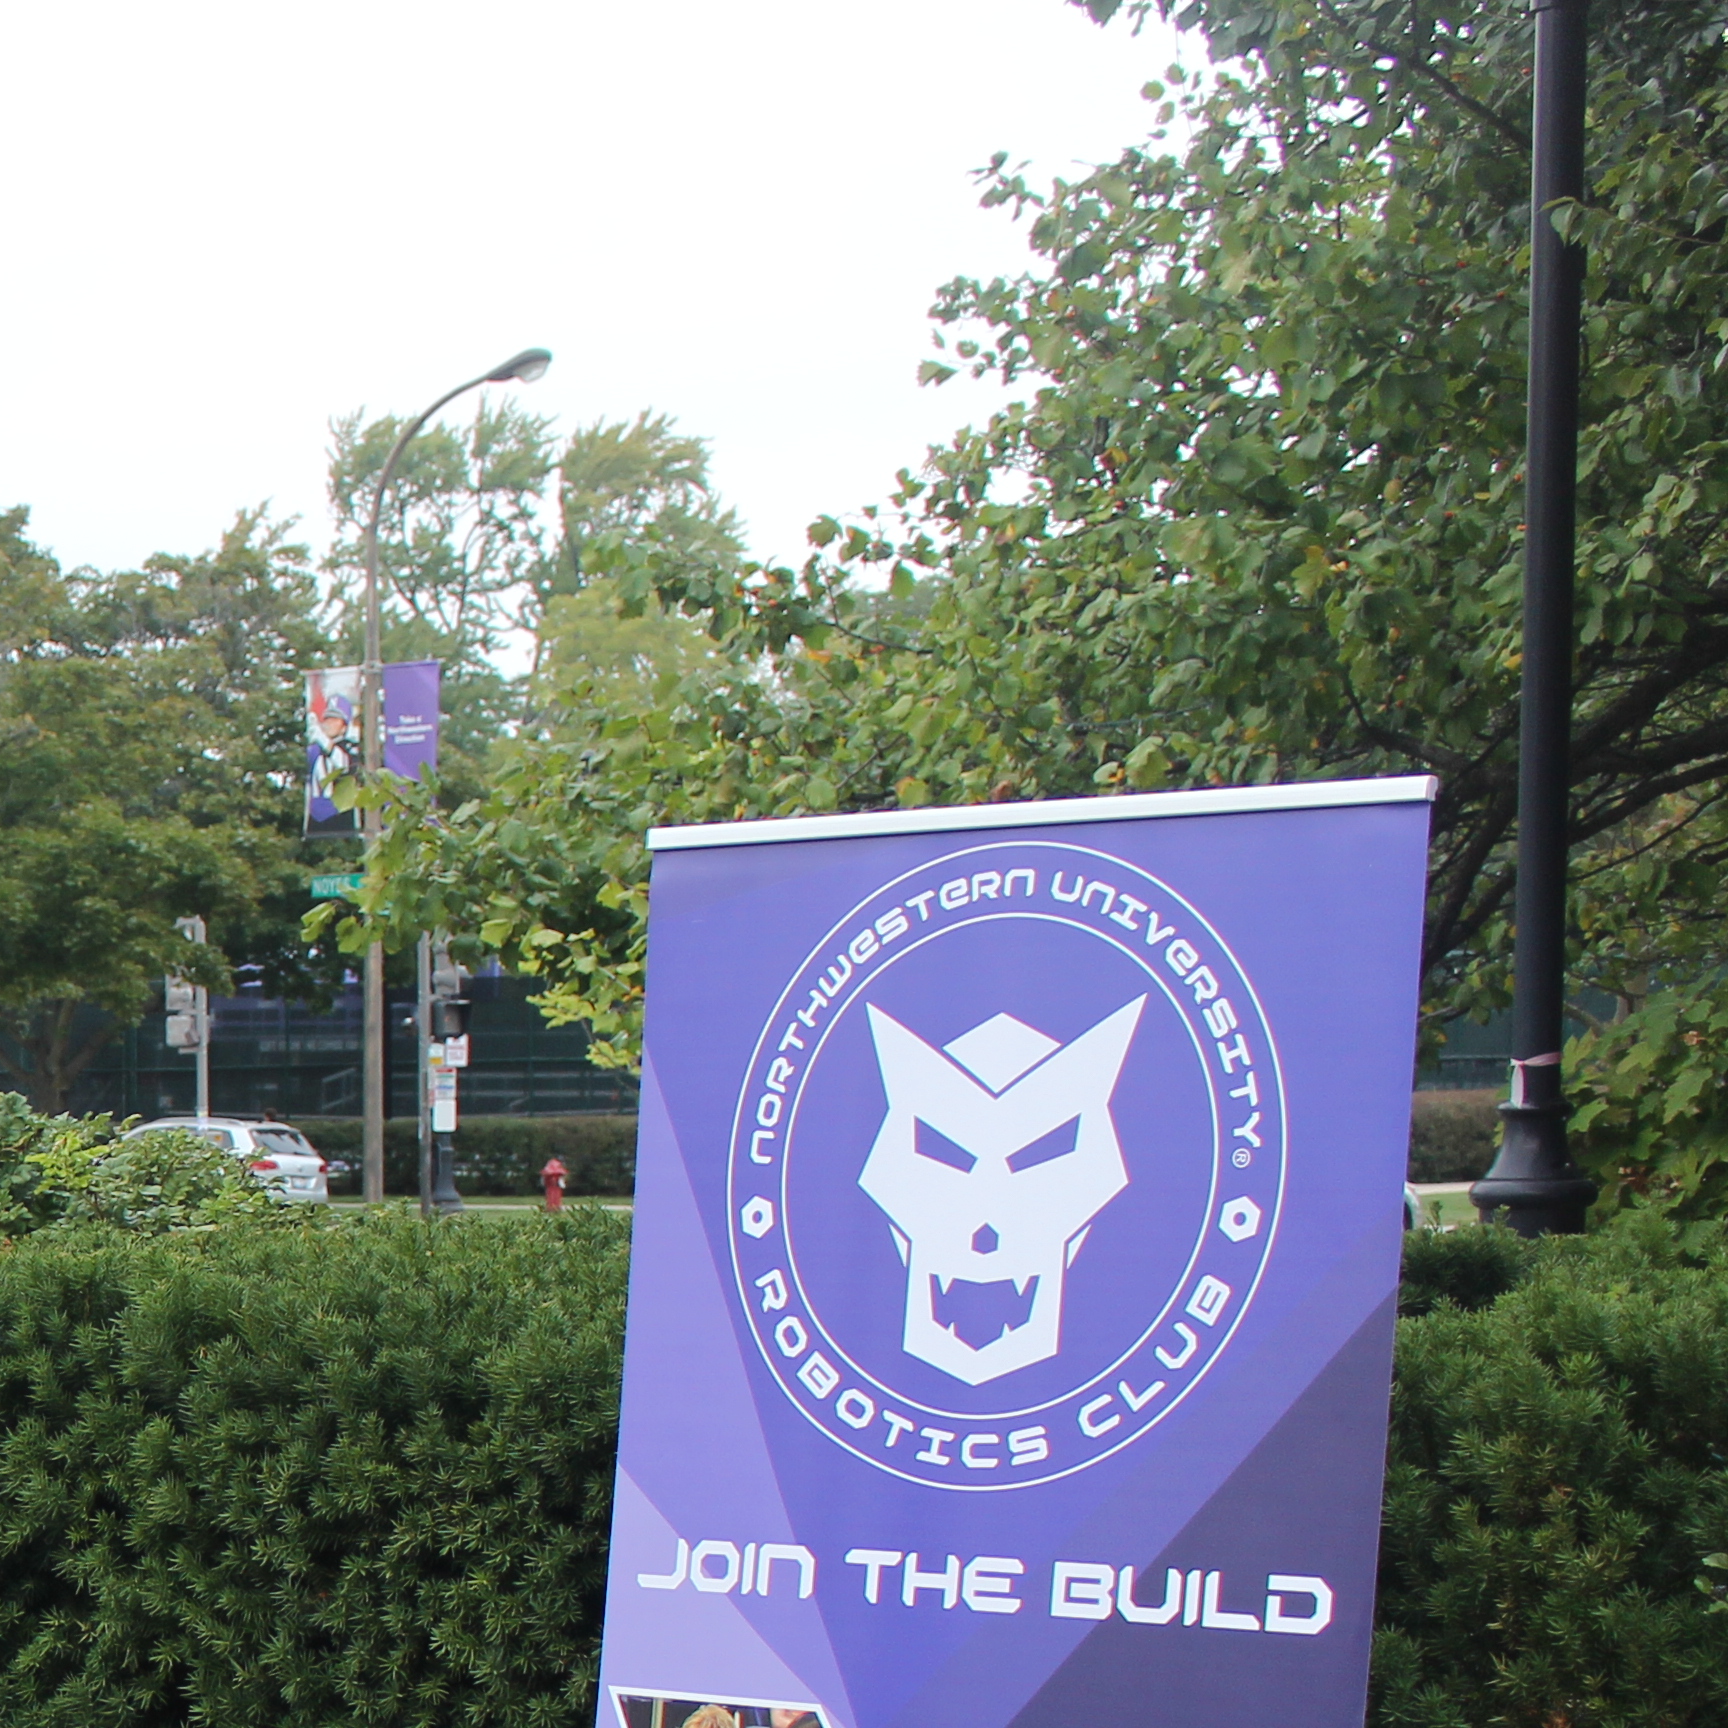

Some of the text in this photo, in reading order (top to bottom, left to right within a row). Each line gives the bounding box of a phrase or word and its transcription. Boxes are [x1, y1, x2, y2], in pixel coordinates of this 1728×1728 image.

[750, 867, 1034, 1164] NORTHWESTERN
[753, 1269, 1231, 1469] ROBOTICS CLUB
[637, 1537, 1332, 1635] JOIN THE BUILD
